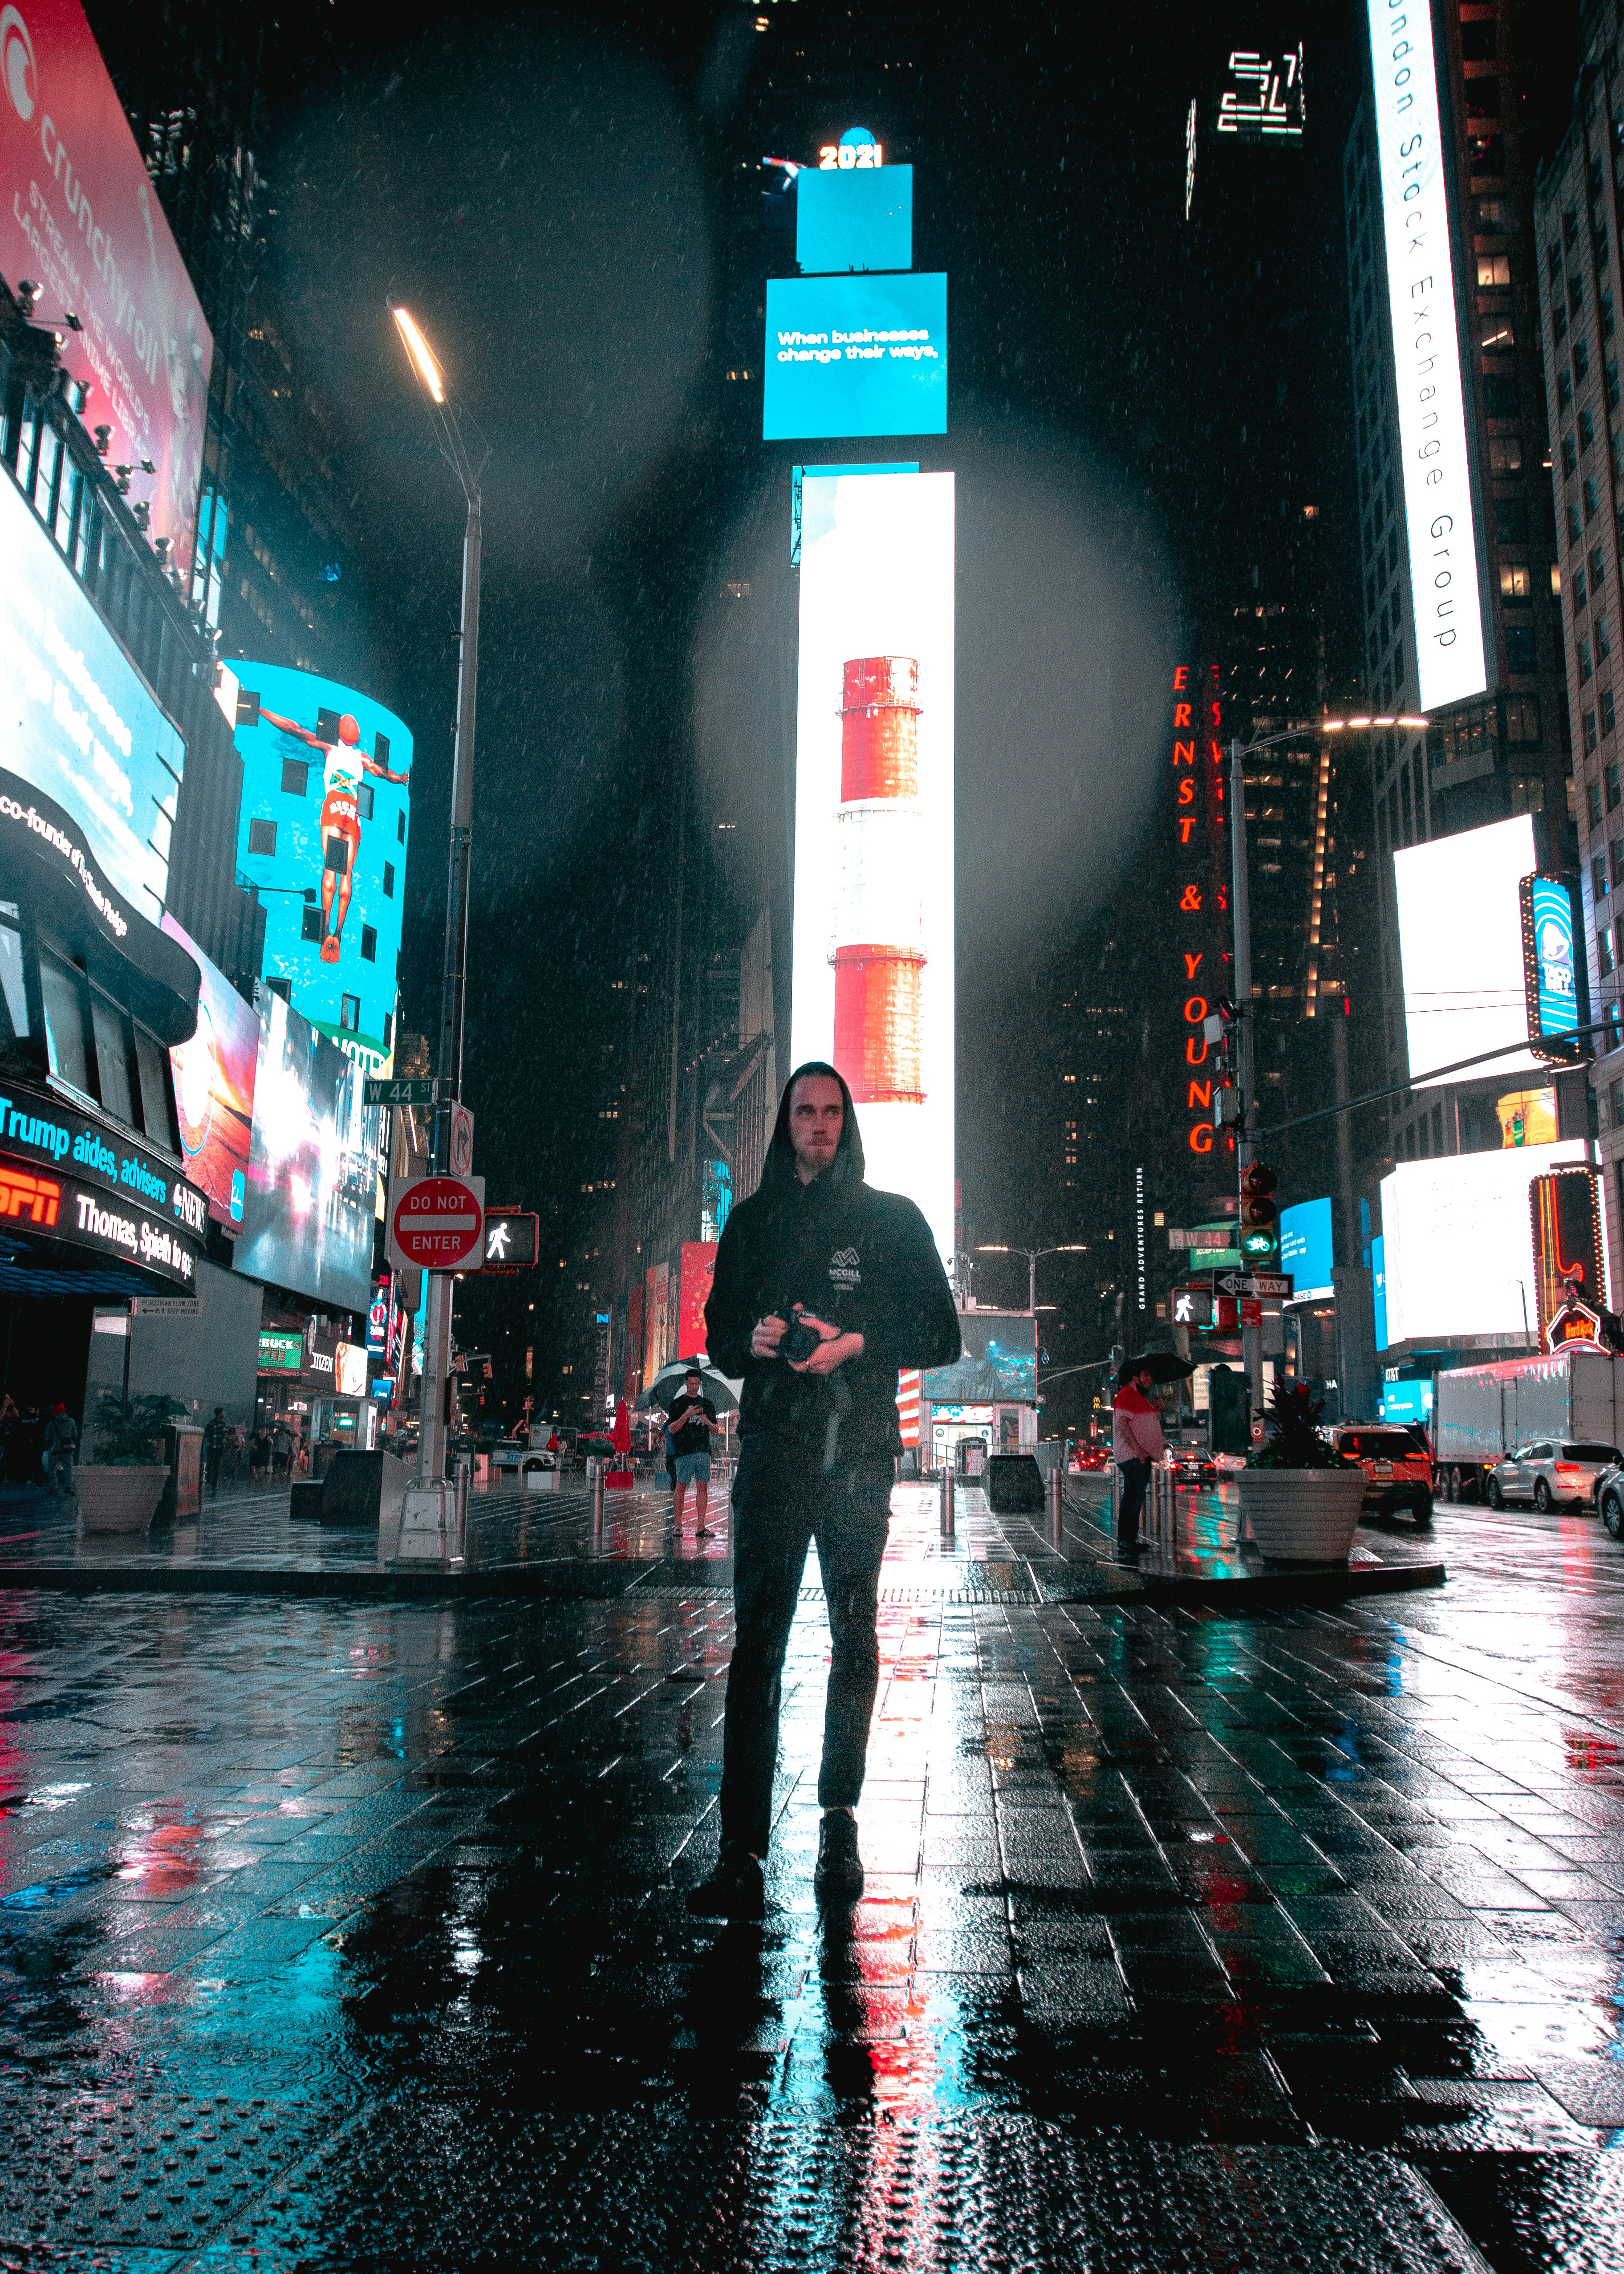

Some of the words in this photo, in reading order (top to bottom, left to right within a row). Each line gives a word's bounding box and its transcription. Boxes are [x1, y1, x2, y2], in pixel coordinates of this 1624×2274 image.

[819, 143, 882, 171] 2021
[1400, 134, 1428, 254] Stock
[777, 331, 828, 346] When
[832, 328, 929, 343] businesses
[777, 348, 842, 363] change
[845, 344, 886, 359] their
[889, 346, 938, 361] ways,
[1412, 275, 1442, 486] Exchange
[1430, 515, 1457, 646] Group
[1173, 666, 1196, 844] ERNST
[0, 795, 73, 857] co-founder
[1180, 885, 1202, 910] &
[1184, 953, 1213, 1153] YOUNG
[369, 1083, 382, 1102] W
[389, 1083, 412, 1102] 44
[421, 1082, 431, 1093] ST
[0, 1098, 69, 1160] Trump
[73, 1131, 118, 1183] aides,
[121, 1158, 166, 1204] advisers
[410, 1196, 430, 1210] DO
[437, 1195, 466, 1209] NOT
[77, 1194, 138, 1254] Thomas,
[140, 1221, 171, 1264] Spieth
[172, 1240, 181, 1269] to
[412, 1236, 461, 1250] ENTER
[1186, 1232, 1198, 1247] W
[1205, 1232, 1221, 1247] 44
[1226, 1278, 1248, 1290] ONE
[1259, 1281, 1283, 1292] WAY
[1385, 1367, 1399, 1383] AT&T
